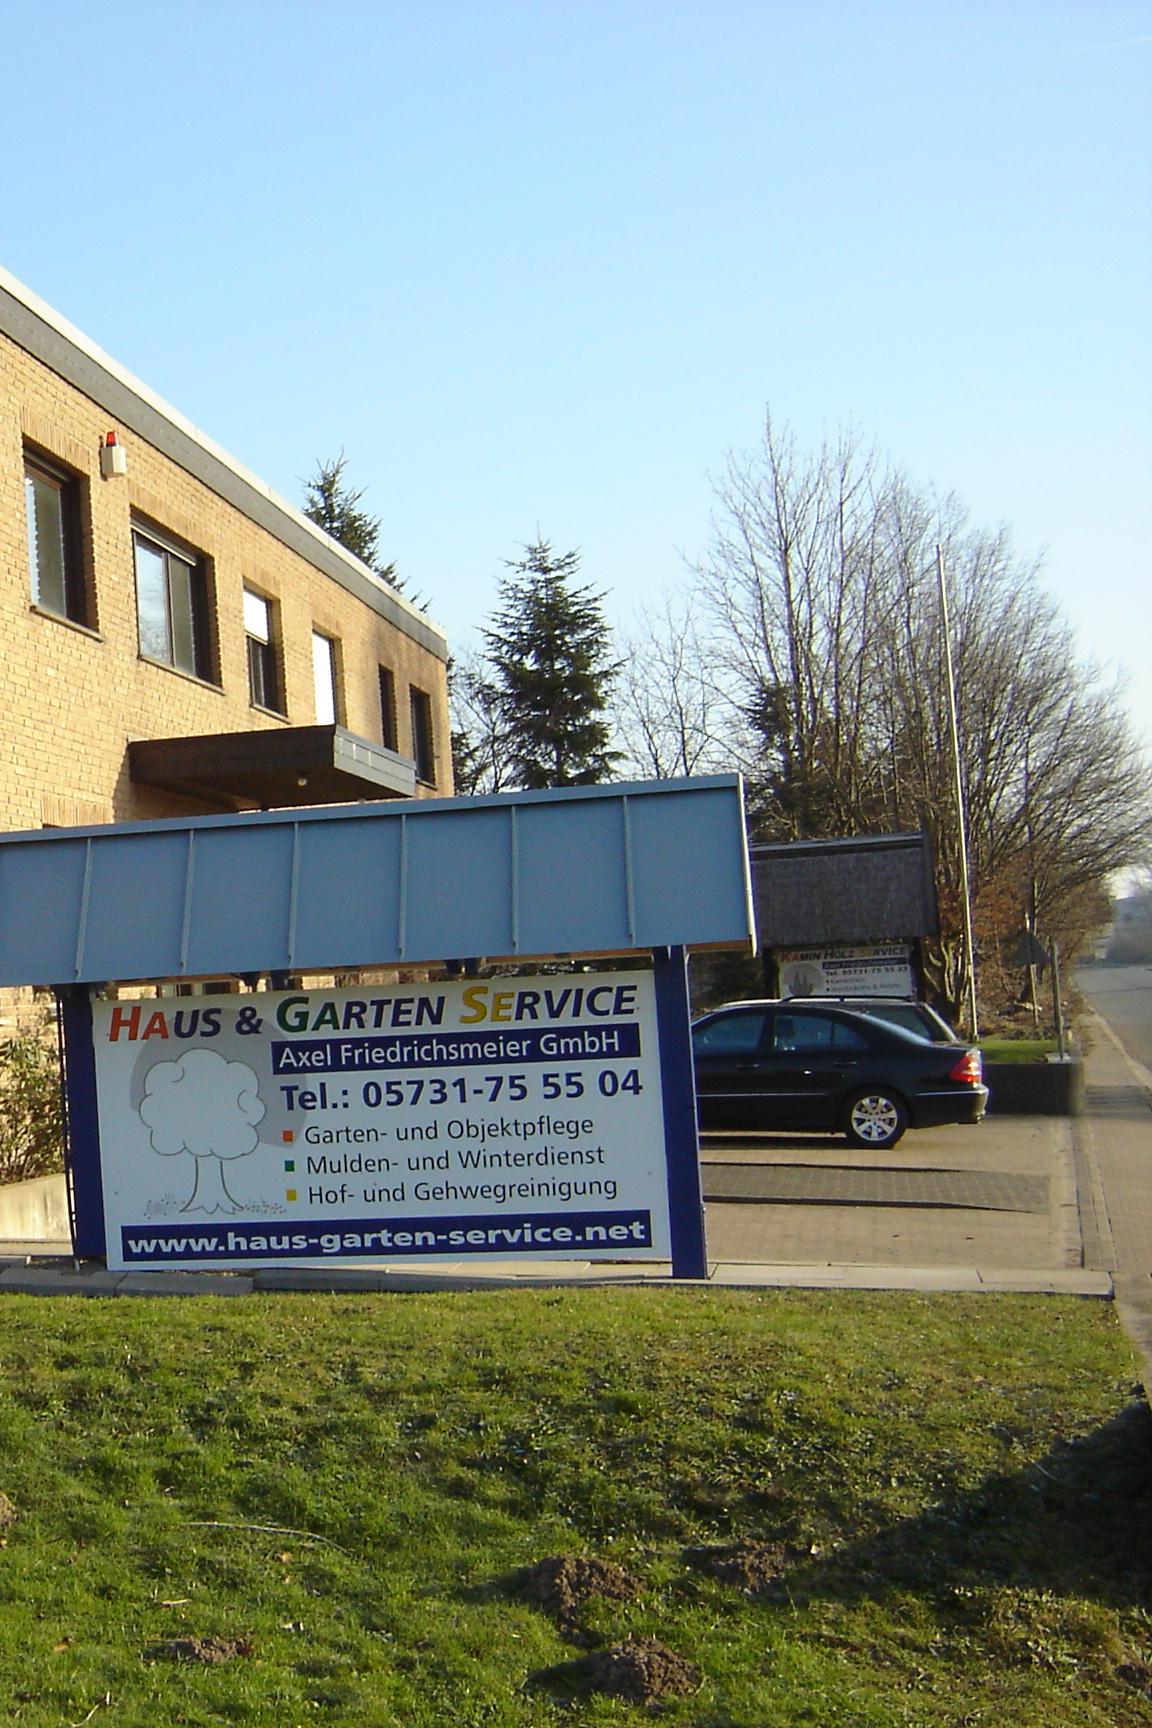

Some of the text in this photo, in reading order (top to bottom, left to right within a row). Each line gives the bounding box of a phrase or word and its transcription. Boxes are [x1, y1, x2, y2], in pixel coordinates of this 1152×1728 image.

[109, 984, 638, 1042] HAUS & GARTEN SERVICE
[279, 1030, 620, 1068] Axel Friedrichsmeier GmbH
[280, 1069, 643, 1111] Tel.: 05731-75 55 04
[305, 1115, 594, 1145] Garten- und Objektpflege
[307, 1146, 605, 1175] Mulden- und Winterdienst
[308, 1177, 617, 1205] Hof- und Gehwegreinigung
[128, 1221, 646, 1254] www.haus-garten-service.net
